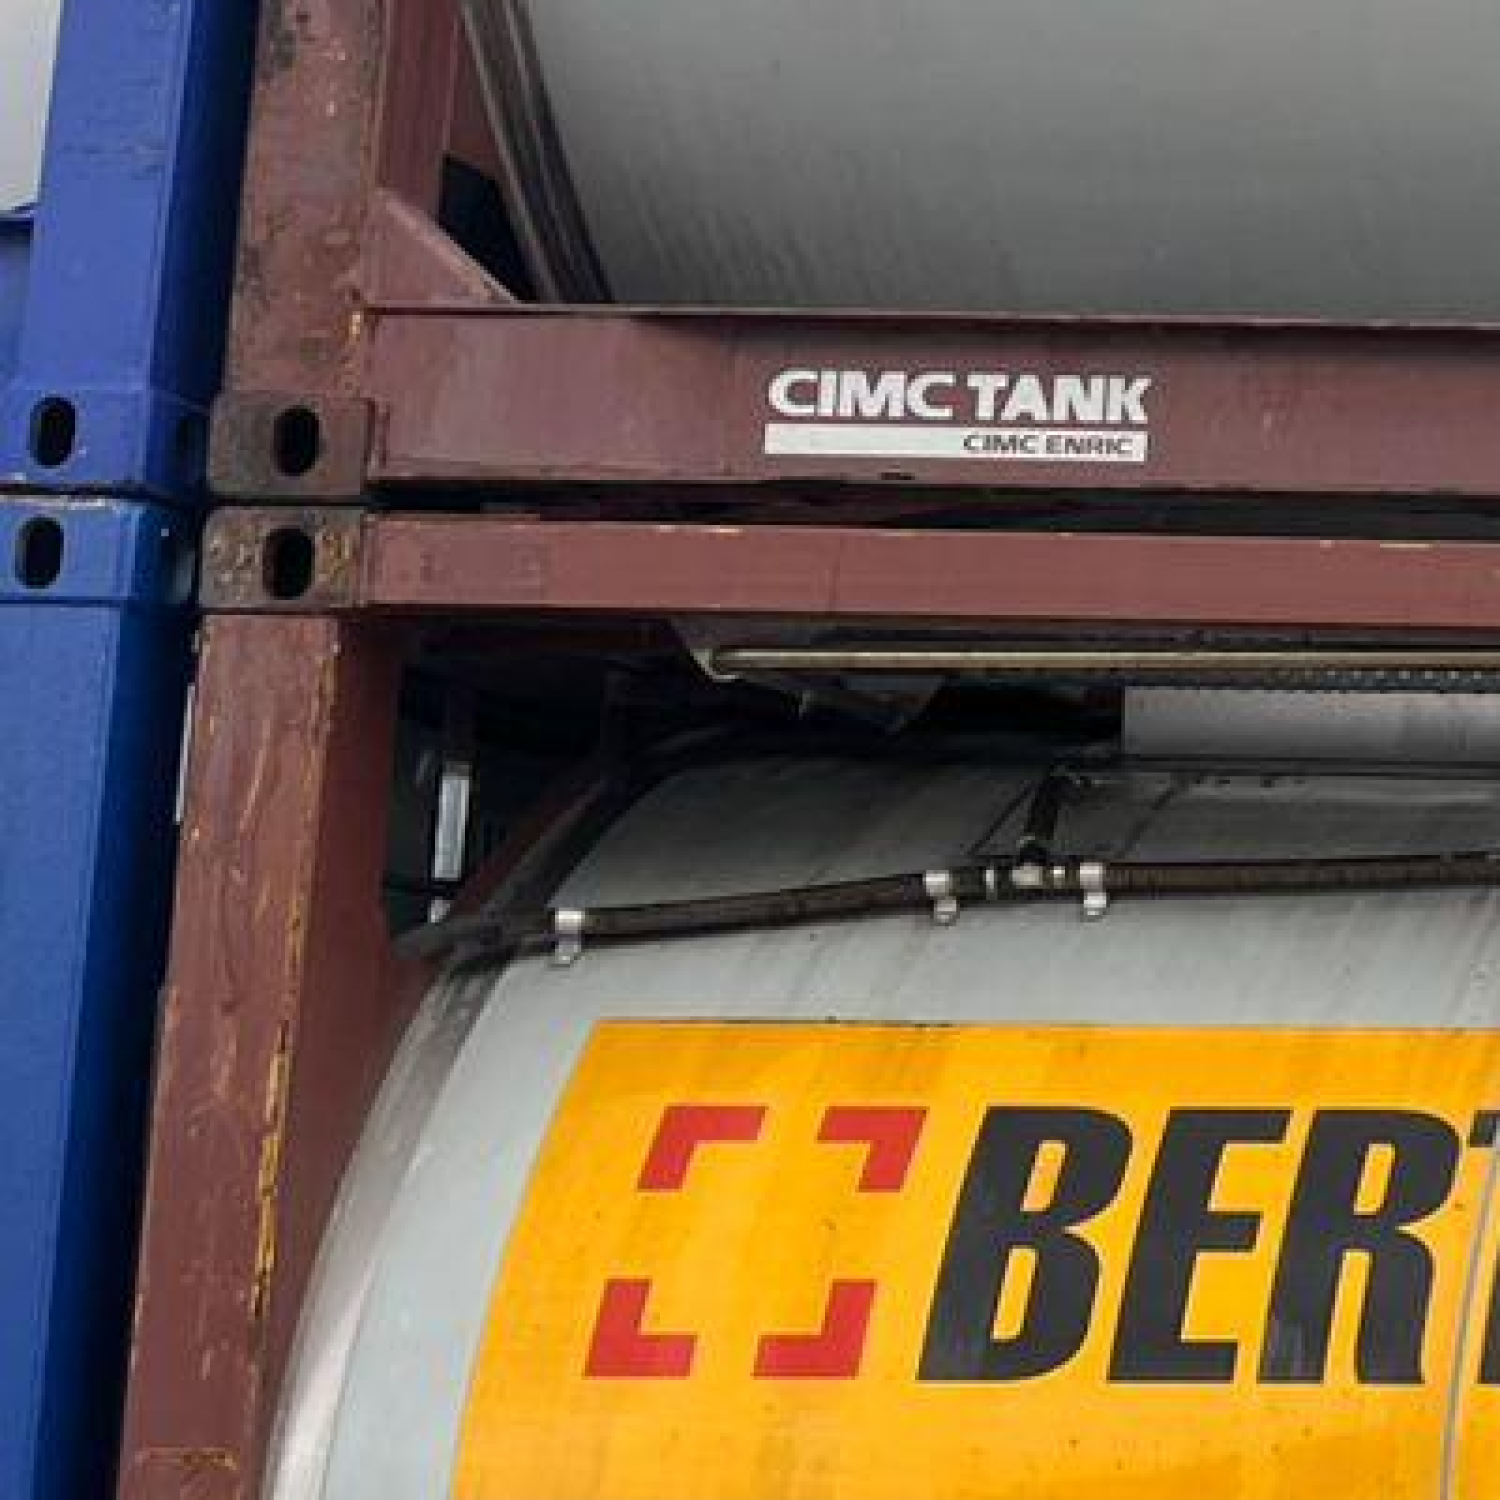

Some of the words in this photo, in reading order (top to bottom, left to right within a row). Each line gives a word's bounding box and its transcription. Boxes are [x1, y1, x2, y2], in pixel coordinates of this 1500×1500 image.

[767, 369, 956, 418] CIMC
[966, 373, 1153, 422] TANK
[962, 433, 1039, 455] CIMC
